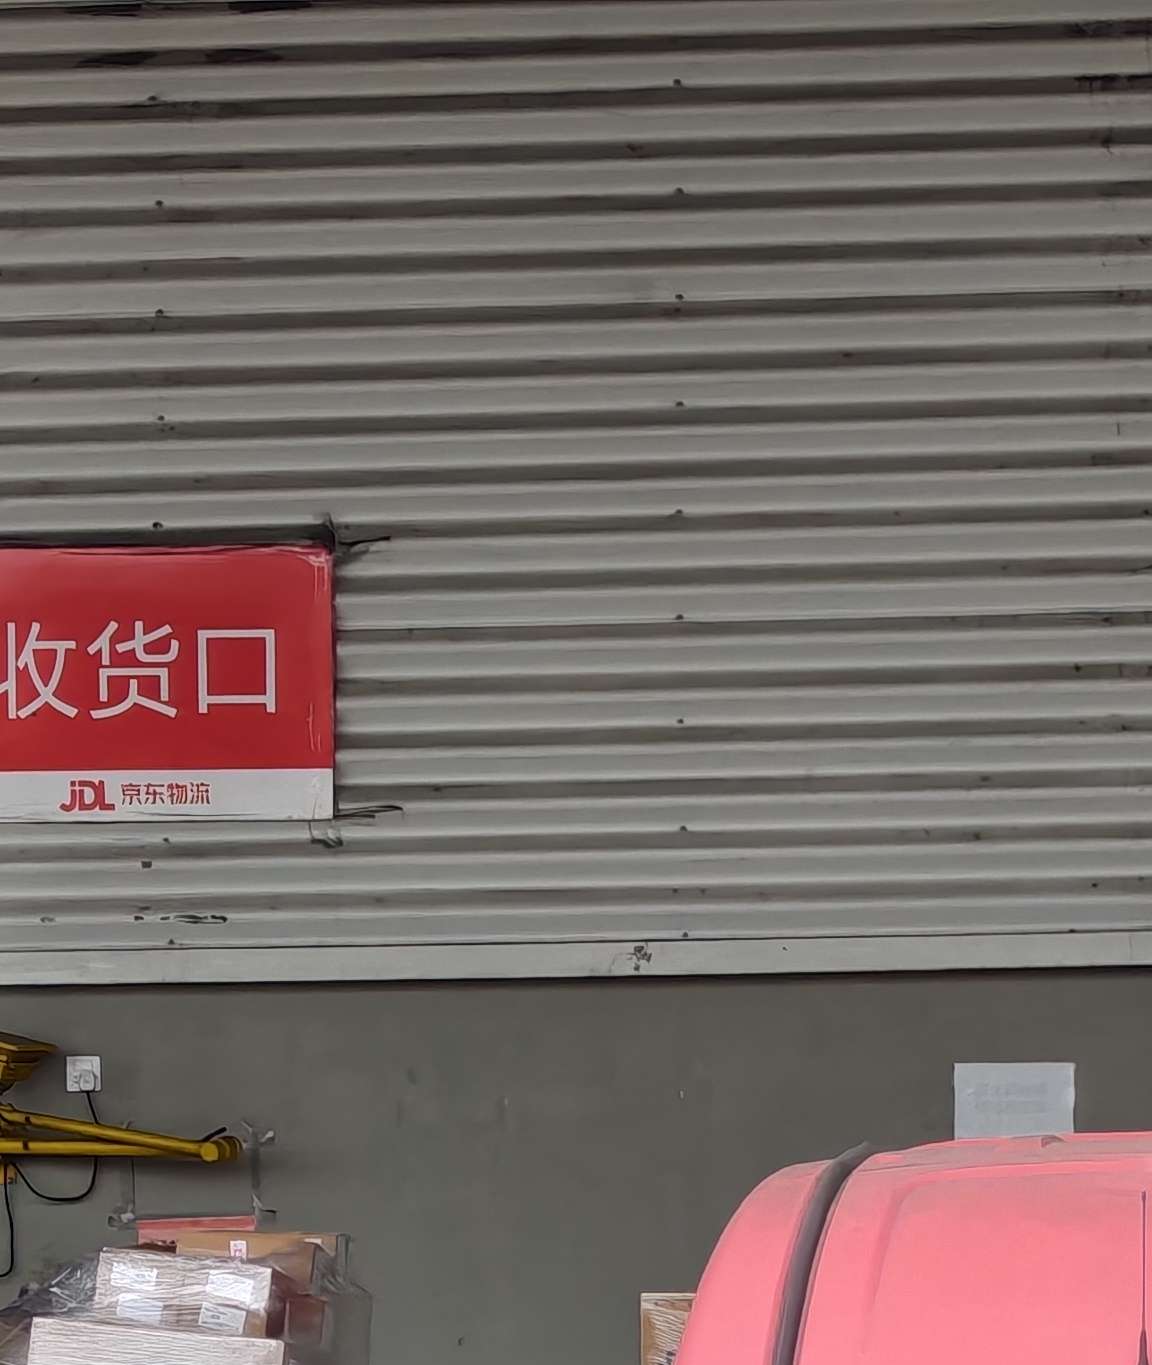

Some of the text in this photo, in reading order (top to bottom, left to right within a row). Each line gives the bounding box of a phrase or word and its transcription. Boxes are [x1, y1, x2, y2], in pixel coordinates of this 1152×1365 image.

[0, 620, 276, 719] 收货口
[59, 779, 211, 812] JDL 京东物流
